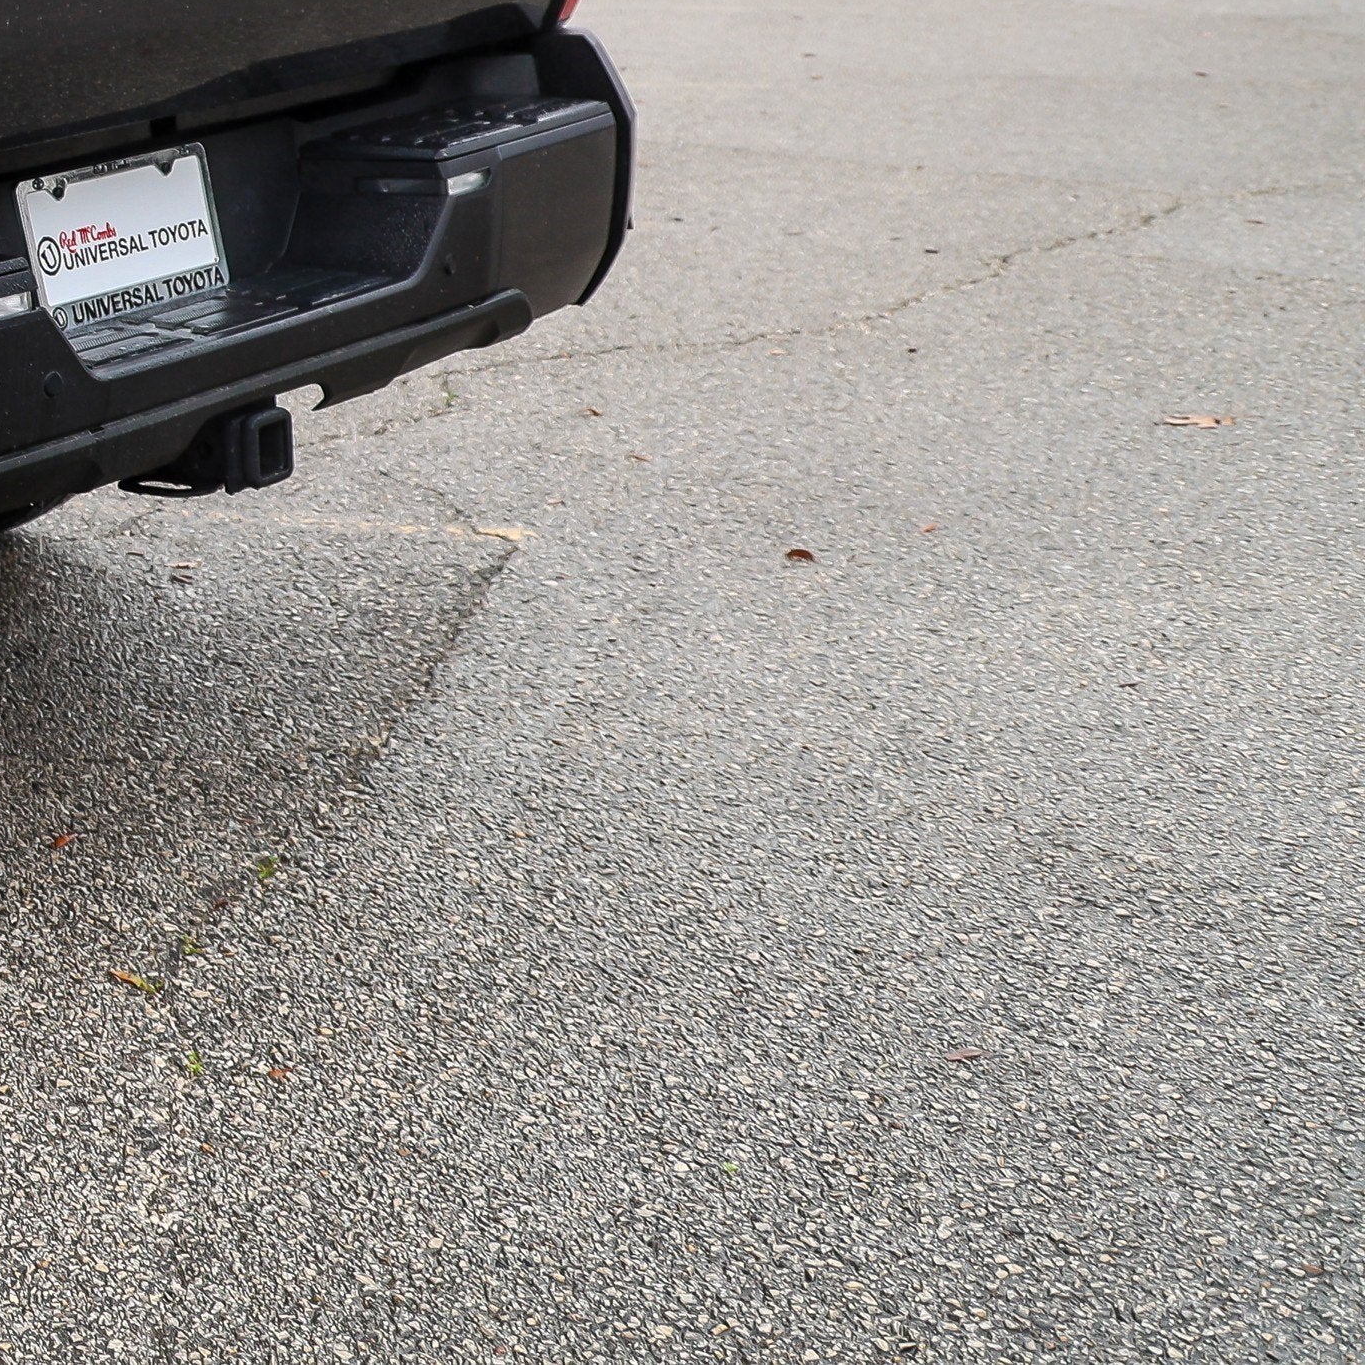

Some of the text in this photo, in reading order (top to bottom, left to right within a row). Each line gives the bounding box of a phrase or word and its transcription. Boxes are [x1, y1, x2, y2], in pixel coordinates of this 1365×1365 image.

[59, 231, 77, 253] Red
[62, 233, 149, 270] UNIVERSAL
[151, 219, 208, 248] TOYOTA
[72, 287, 165, 325] UNIVERSAL
[164, 265, 225, 299] TOYOTA
